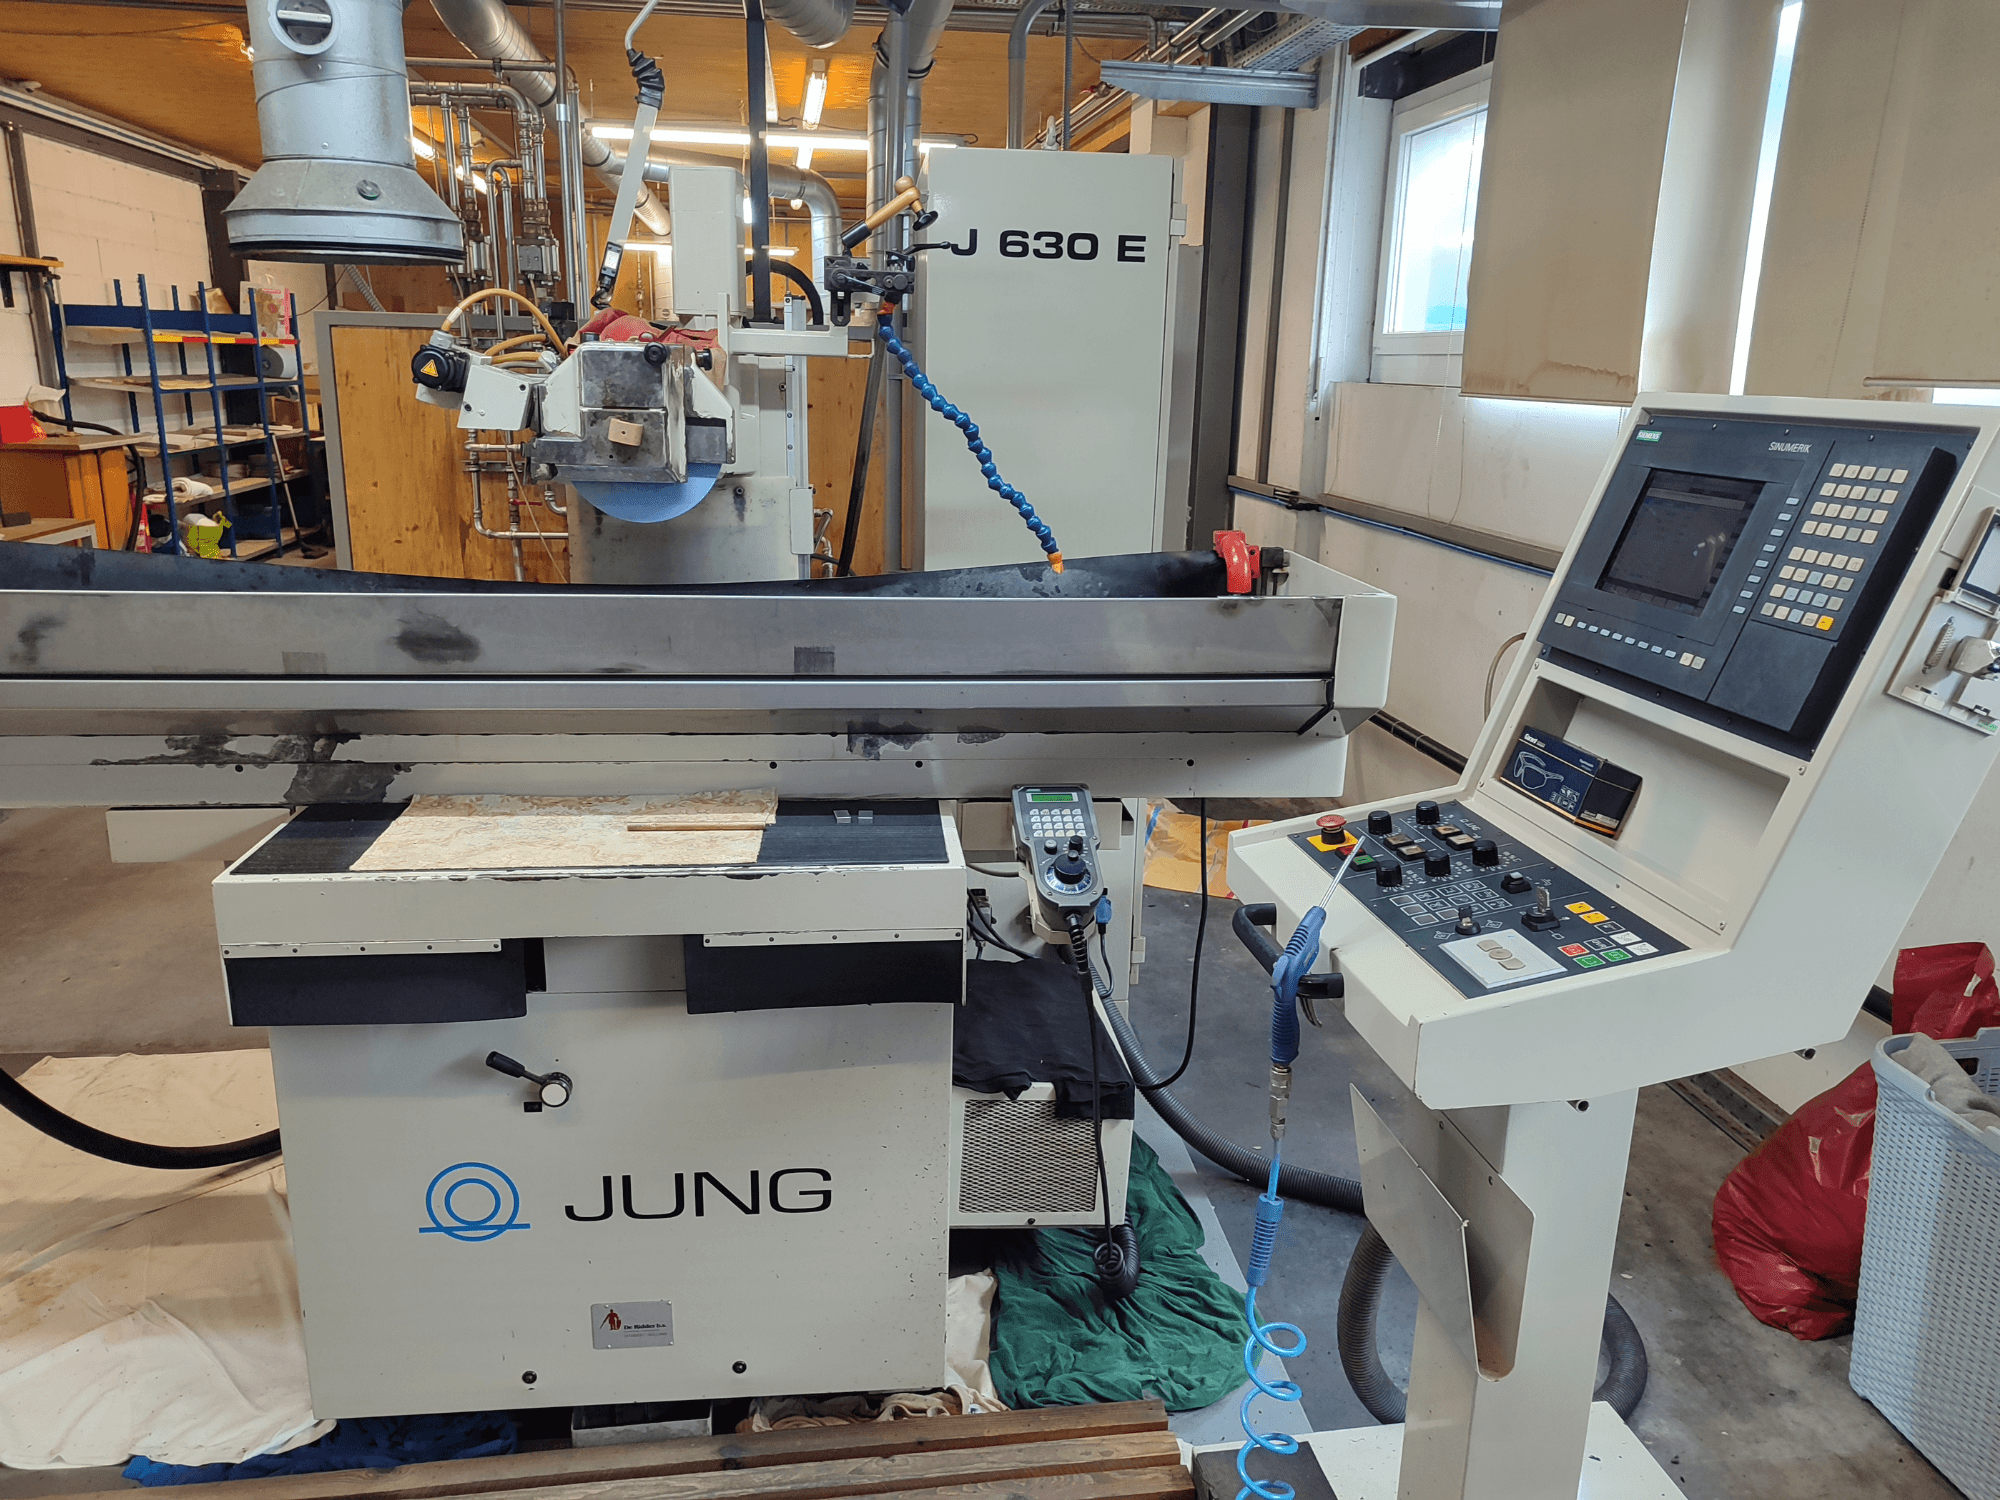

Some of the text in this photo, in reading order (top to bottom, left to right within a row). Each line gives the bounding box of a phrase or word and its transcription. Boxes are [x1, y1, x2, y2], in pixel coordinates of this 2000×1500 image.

[950, 228, 1147, 263] J 630 E
[1768, 441, 1813, 454] SINUMERIK
[564, 1168, 832, 1222] JUNG
